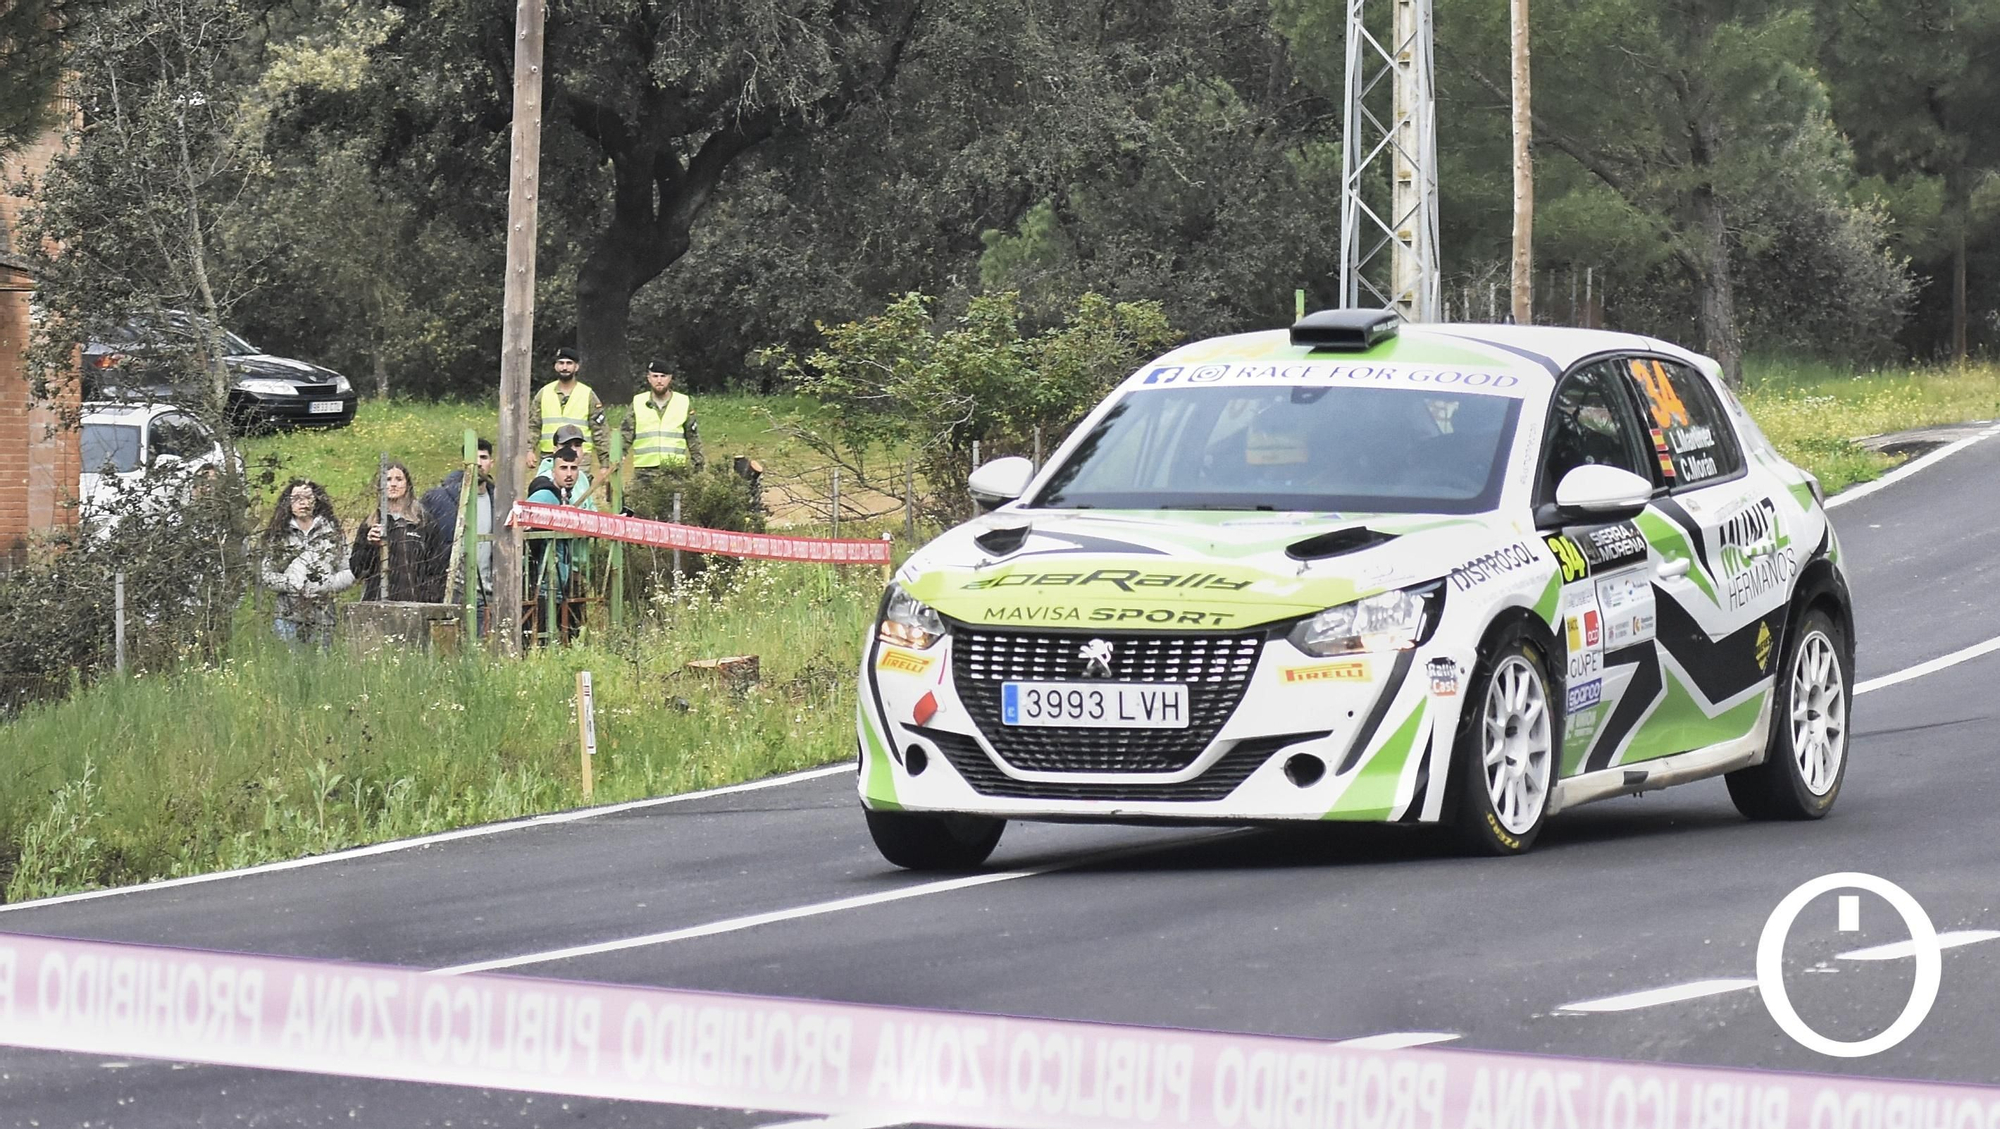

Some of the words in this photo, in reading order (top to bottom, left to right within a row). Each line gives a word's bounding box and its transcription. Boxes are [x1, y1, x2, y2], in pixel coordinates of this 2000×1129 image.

[1235, 365, 1321, 380] RACE
[1329, 366, 1398, 382] FOR
[1407, 369, 1519, 389] GOOD
[1630, 360, 1688, 429] 34
[1589, 524, 1631, 547] SIERRA
[1547, 535, 1586, 582] 34
[1599, 536, 1646, 562] MORENA
[1450, 541, 1540, 592] DISPROSOL
[1728, 547, 1798, 613] HERMANOS
[983, 606, 1081, 622] MAVISA
[1088, 607, 1236, 627] SPORT
[882, 651, 930, 674] PIRELLI
[1285, 663, 1364, 682] PIRELLI
[1427, 662, 1457, 679] Rally
[1432, 678, 1457, 694] Cast
[1026, 689, 1105, 720] 3993
[1118, 691, 1180, 721] LVH
